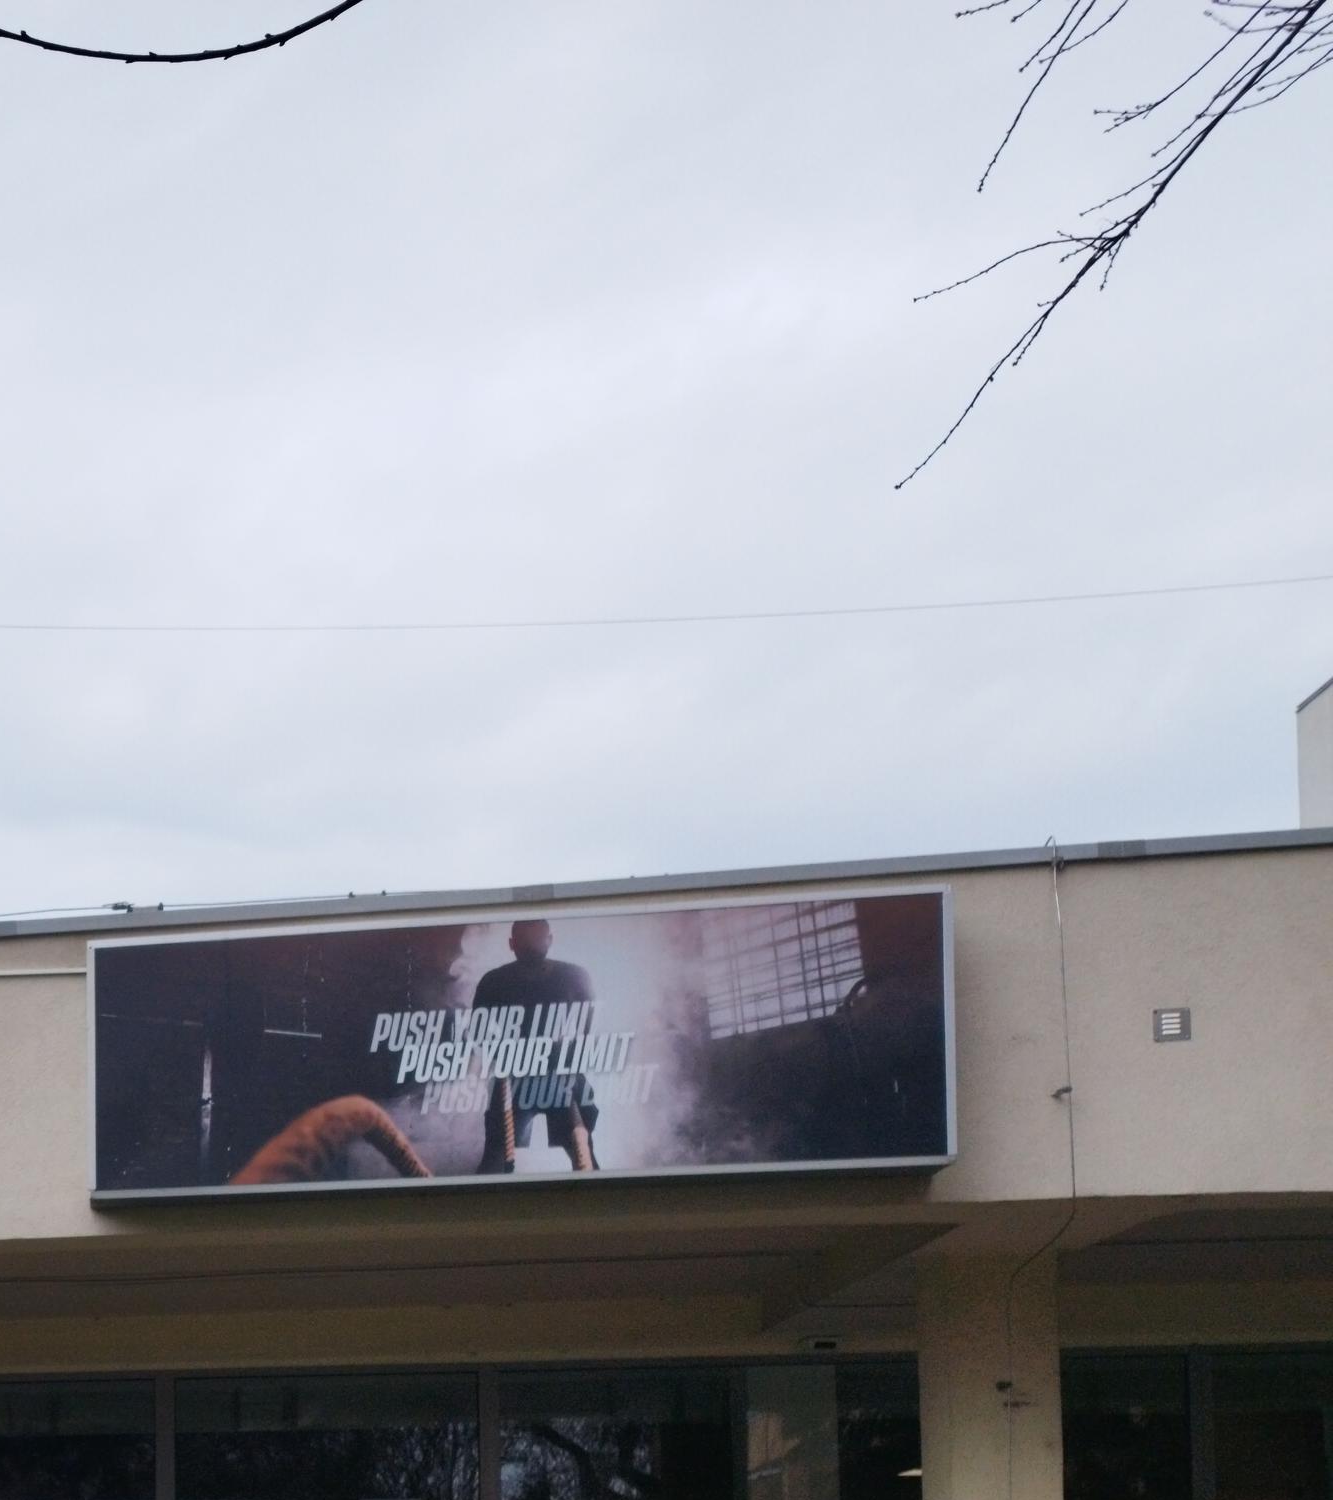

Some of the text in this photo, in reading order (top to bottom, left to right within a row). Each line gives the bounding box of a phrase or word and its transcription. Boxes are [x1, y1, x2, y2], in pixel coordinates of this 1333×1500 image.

[370, 1000, 606, 1053] PUSH YOUR LIMIT
[397, 1032, 635, 1084] PUSH YOUR LIMIT
[420, 1074, 492, 1115] PUSH
